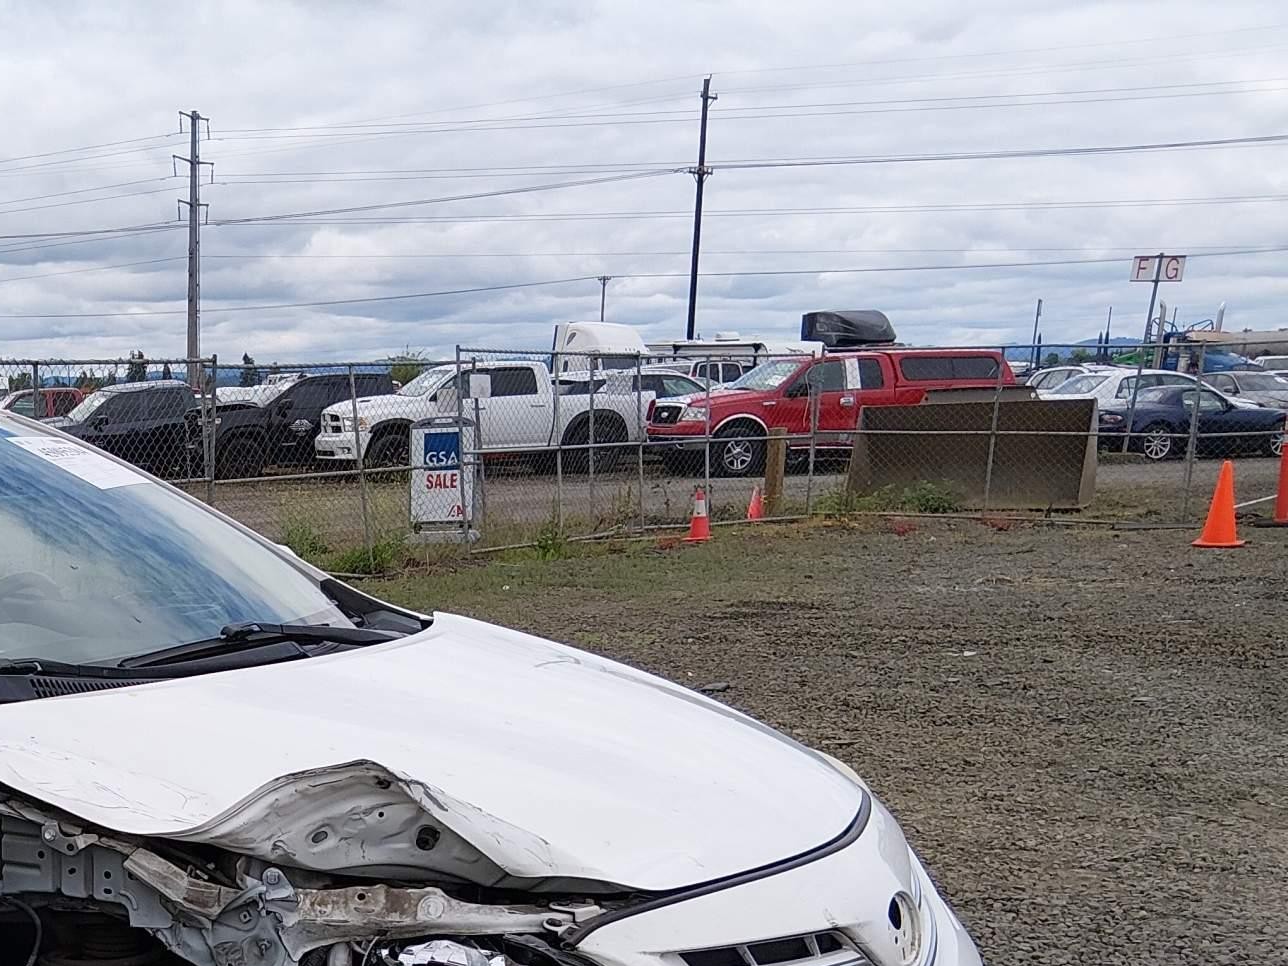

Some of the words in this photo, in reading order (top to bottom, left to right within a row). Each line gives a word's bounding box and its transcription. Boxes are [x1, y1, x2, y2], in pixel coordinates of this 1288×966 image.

[1136, 258, 1149, 279] F
[1165, 257, 1179, 279] G
[426, 451, 458, 465] GSA
[426, 473, 457, 489] SALE
